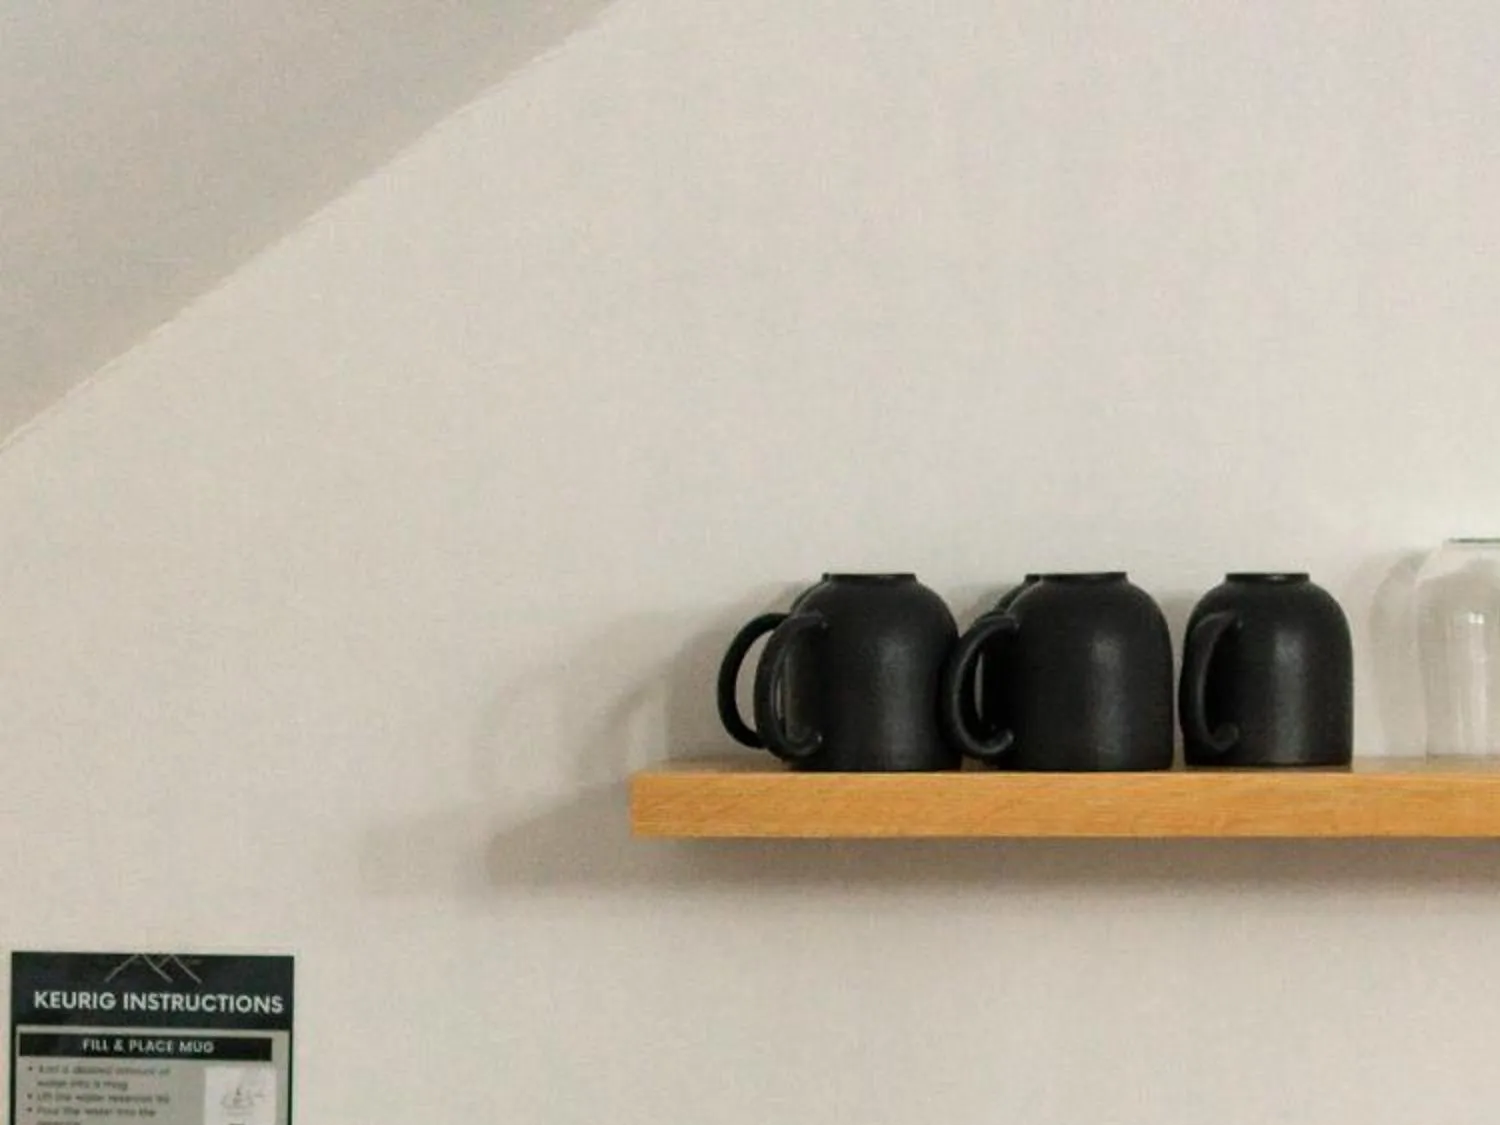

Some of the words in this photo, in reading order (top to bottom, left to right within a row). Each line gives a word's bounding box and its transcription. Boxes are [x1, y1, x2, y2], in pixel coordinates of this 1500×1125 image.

[34, 990, 116, 1010] KEURIG
[123, 992, 284, 1014] INSTRUCTIONS
[83, 1039, 108, 1051] FILL
[114, 1040, 123, 1051] &
[129, 1040, 173, 1052] PLACE
[179, 1041, 215, 1053] MUG
